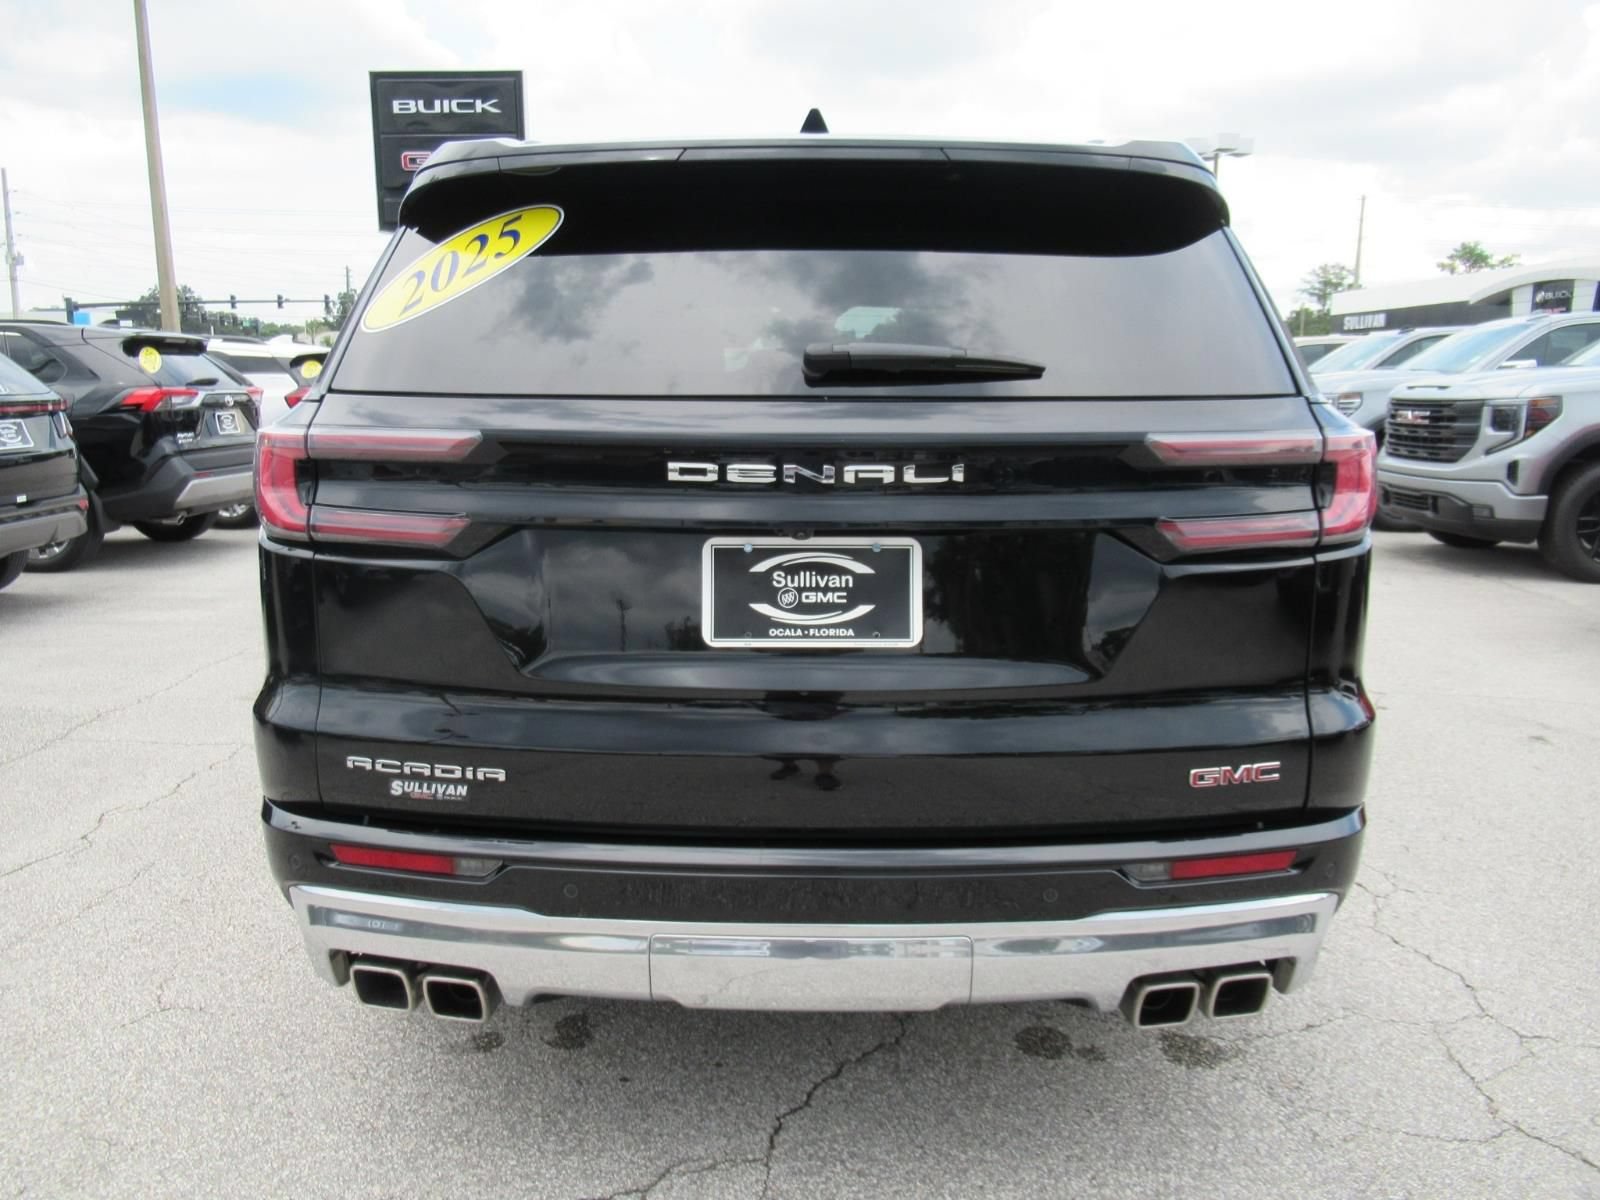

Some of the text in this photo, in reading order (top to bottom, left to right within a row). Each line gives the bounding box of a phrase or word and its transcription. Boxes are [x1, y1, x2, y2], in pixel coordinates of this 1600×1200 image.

[391, 99, 502, 114] BUICK
[396, 214, 524, 319] 2025
[667, 461, 965, 484] DENALI
[772, 571, 853, 588] Sullivan
[801, 592, 847, 603] GMC
[768, 628, 855, 638] OCALA FLORIDA
[346, 755, 507, 782] ACADIA
[1189, 761, 1281, 788] GMC
[390, 780, 468, 796] SULLIVAN
